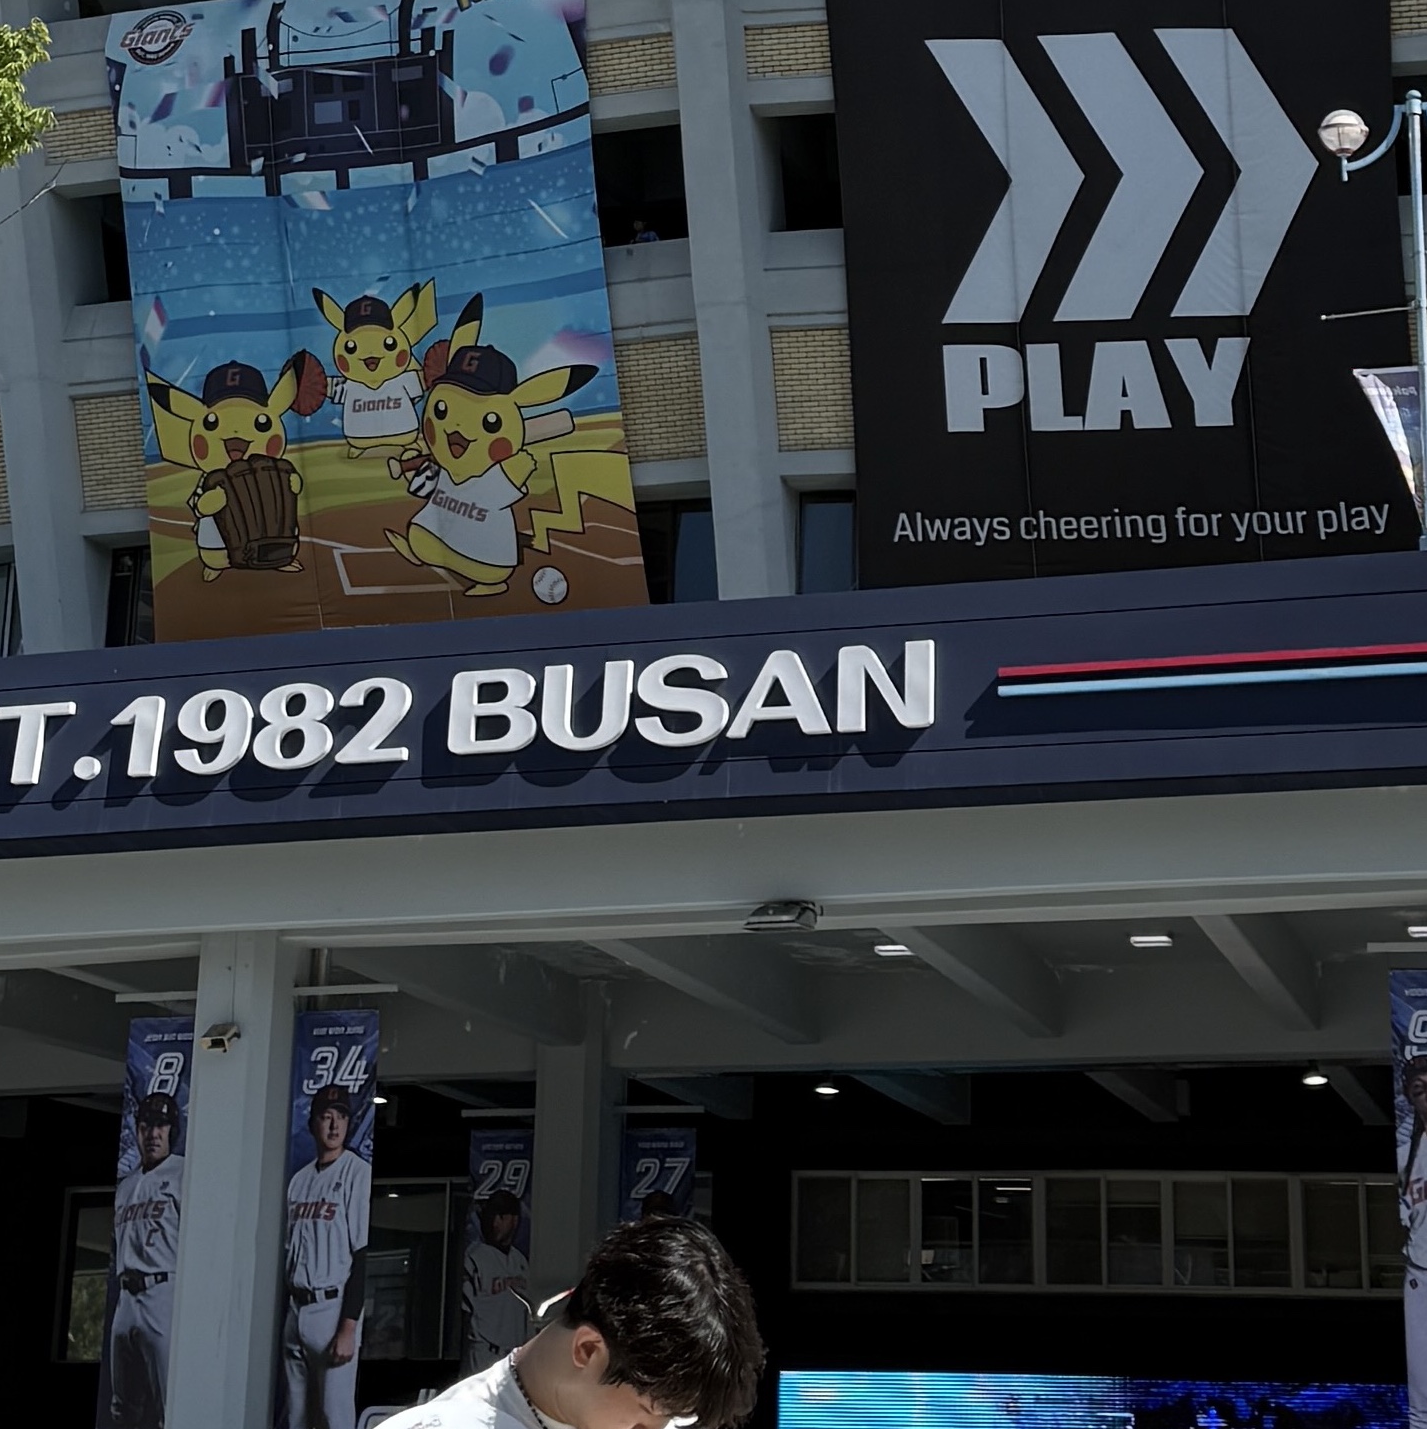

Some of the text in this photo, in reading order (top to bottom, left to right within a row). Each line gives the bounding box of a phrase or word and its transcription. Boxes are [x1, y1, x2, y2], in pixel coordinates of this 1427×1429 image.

[351, 396, 403, 416] Giants
[942, 336, 1250, 432] PLAY
[429, 486, 490, 523] Giants
[893, 500, 1391, 546] Always cheering for your play
[447, 638, 936, 756] BUSAN
[146, 1052, 185, 1097] 8
[302, 1045, 369, 1096] 34
[473, 1158, 531, 1200] 29
[629, 1157, 691, 1199] 27
